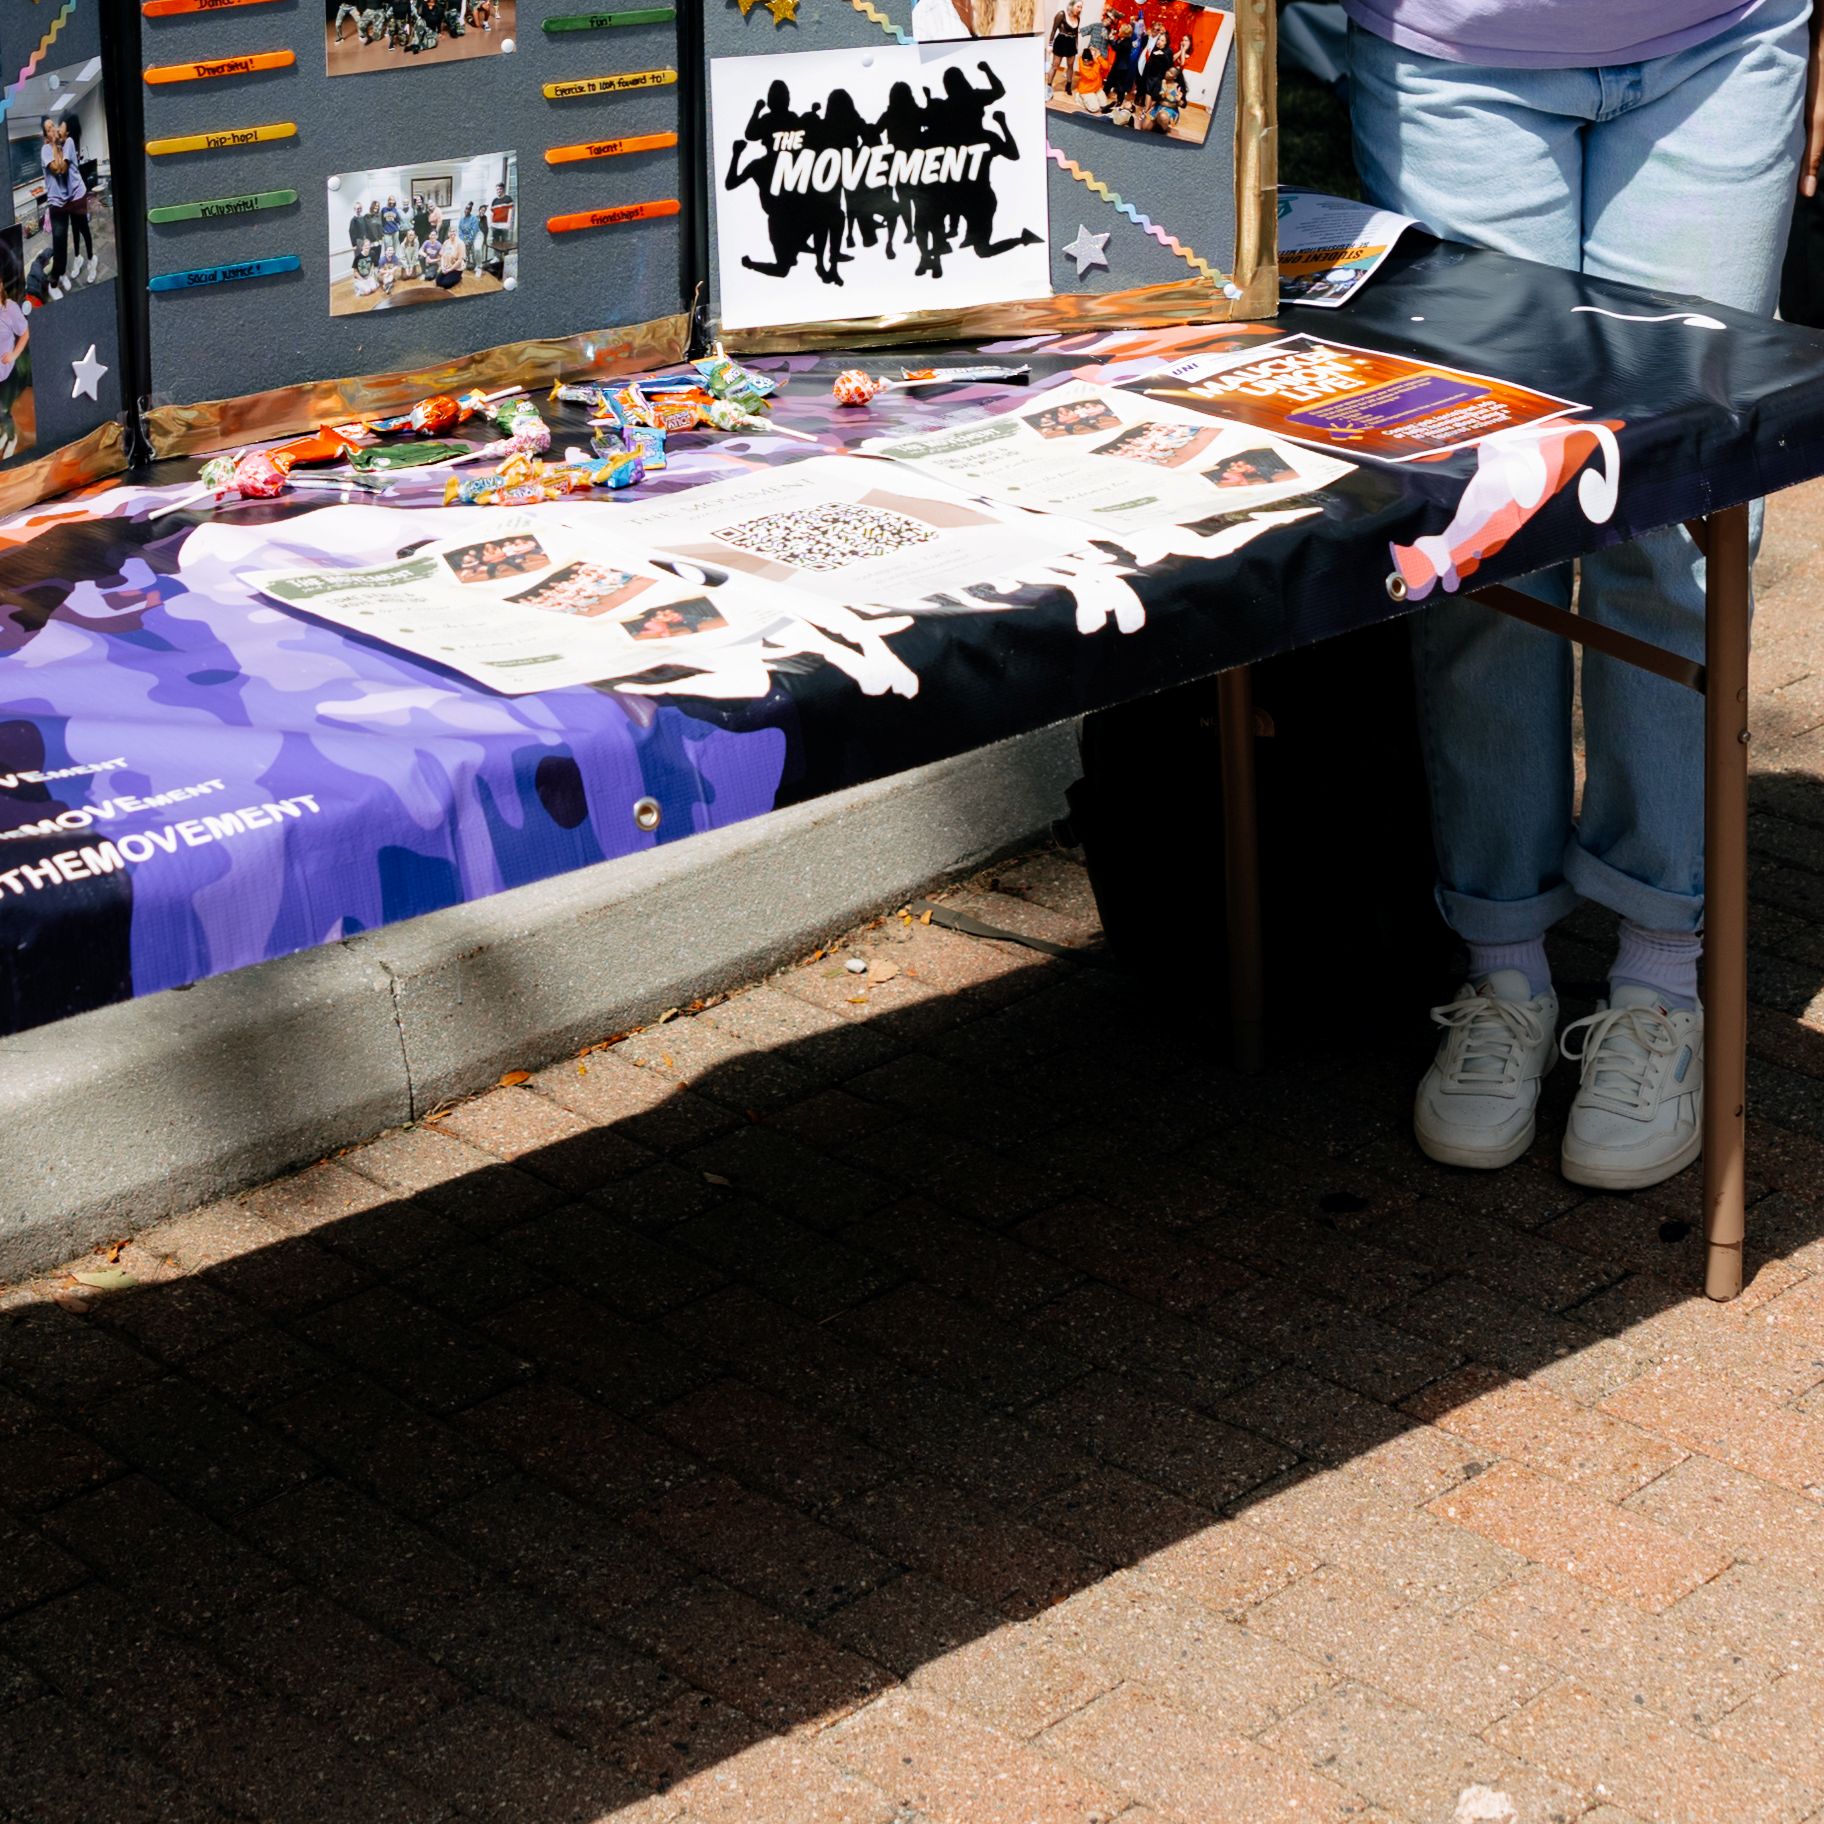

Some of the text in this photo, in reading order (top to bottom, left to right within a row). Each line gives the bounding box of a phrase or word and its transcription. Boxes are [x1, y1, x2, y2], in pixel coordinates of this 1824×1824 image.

[194, 58, 256, 78] Diversity!
[587, 82, 597, 93] to
[206, 130, 258, 148] hip-hop!
[586, 141, 624, 156] Talent!
[770, 128, 806, 152] THE
[770, 140, 992, 197] MOVEMENT
[199, 197, 260, 218] inclusivity!
[1301, 249, 1364, 264] STUDENT
[1171, 362, 1200, 376] UNI
[1238, 361, 1355, 397] UNION
[1278, 375, 1367, 402] LIVE!
